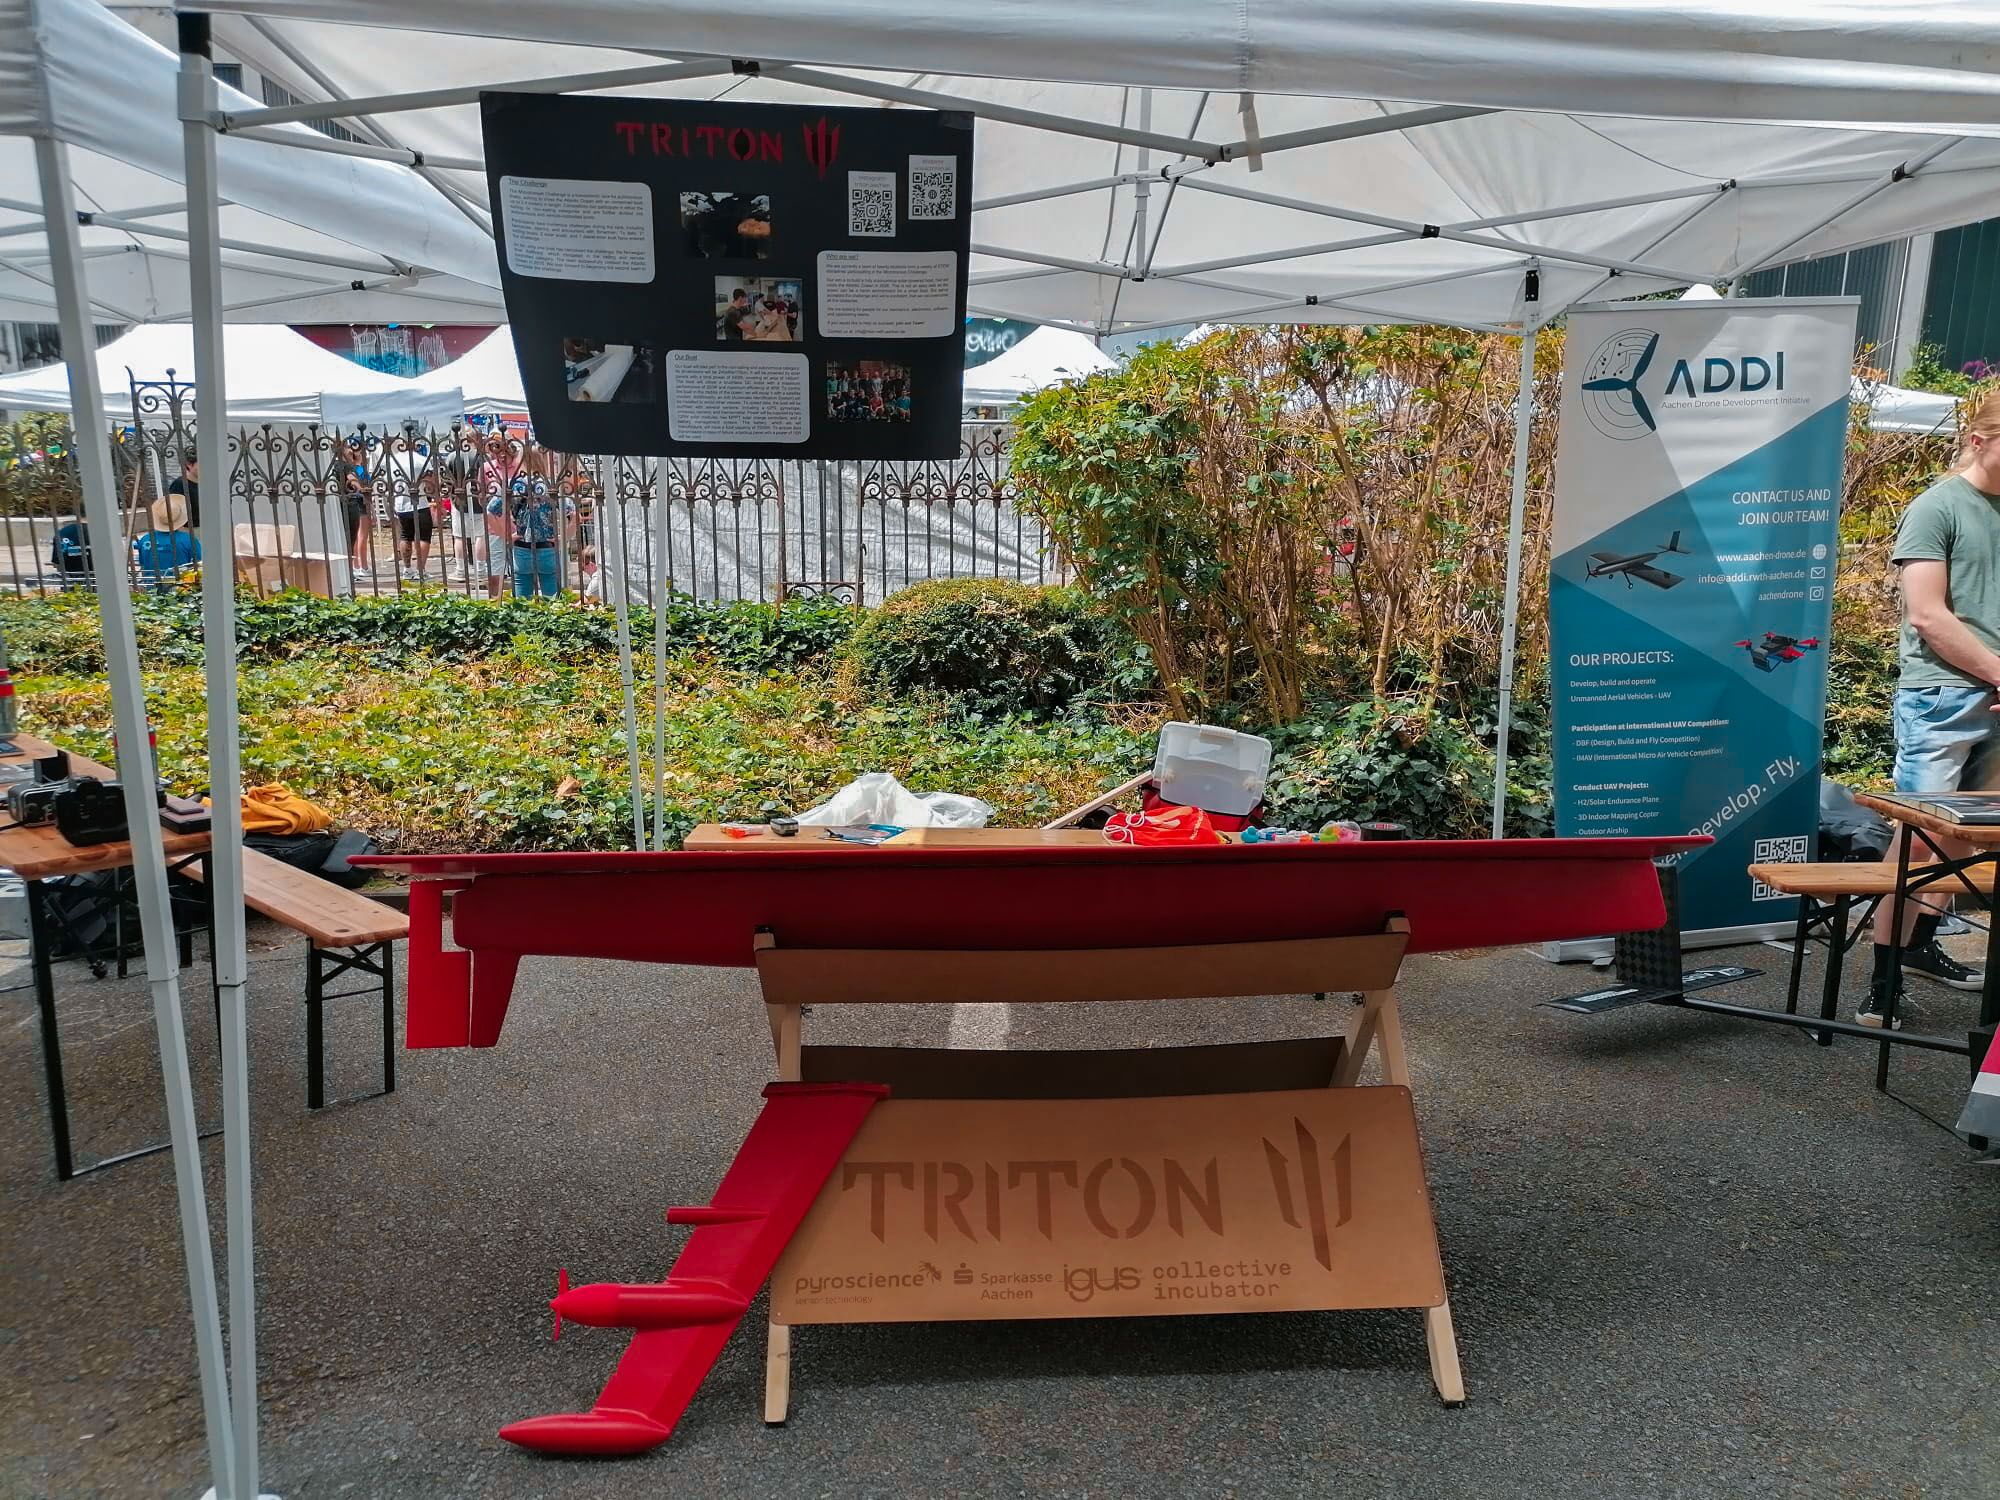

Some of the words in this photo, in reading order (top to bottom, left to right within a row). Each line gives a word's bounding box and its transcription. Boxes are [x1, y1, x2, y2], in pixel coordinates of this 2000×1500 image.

[615, 121, 784, 164] TRITON
[1664, 351, 1784, 398] ADDI
[1661, 401, 1693, 409] Aachen
[1695, 399, 1721, 408] Drone
[1722, 397, 1778, 407] Development
[1780, 396, 1811, 404] Initiative
[1732, 489, 1789, 505] CONTACT
[1791, 489, 1805, 502] US
[1806, 488, 1831, 501] AND
[1738, 512, 1769, 525] JOIN
[1772, 510, 1794, 524] OUR
[1795, 509, 1829, 522] TEAM!
[1716, 549, 1807, 562] www.aachen-drone.de
[1698, 569, 1805, 584] info@addi.rwth-aachen.de
[1758, 589, 1804, 601] aachendrone
[1570, 653, 1600, 667] OUR
[1603, 651, 1674, 665] PROJECTS:
[1570, 679, 1599, 688] Develop,
[1600, 678, 1617, 687] build
[1618, 678, 1631, 686] and
[1632, 677, 1656, 686] operate
[1570, 694, 1607, 702] Unmanned
[1627, 692, 1653, 700] Vehicles
[1571, 723, 1617, 732] Participation
[1672, 720, 1686, 728] UAV
[1576, 739, 1590, 747] DBF
[1590, 738, 1617, 747] (Design,
[1617, 737, 1635, 745] Build
[1635, 736, 1648, 744] and
[1649, 736, 1659, 745] Fly
[1659, 735, 1700, 744] Competition)
[1594, 752, 1638, 761] (International
[1638, 751, 1656, 759] Micro
[1667, 749, 1688, 758] Vehicle
[1573, 783, 1602, 791] Conduct
[1603, 782, 1617, 790] UAV
[1618, 781, 1649, 791] Projects:
[1577, 797, 1606, 806] H2/Solar
[1607, 796, 1641, 805] Endurance
[1642, 795, 1659, 804] Plane
[1688, 782, 1767, 837] Develop.
[1765, 755, 1801, 785] Fly.
[1578, 813, 1586, 821] 3D
[1587, 812, 1609, 820] Indoor
[1610, 811, 1638, 821] Mapping
[1639, 810, 1659, 819] Copter
[1578, 827, 1605, 835] Outdoor
[1606, 826, 1628, 835] Airship
[843, 1156, 1223, 1243] TRITON
[1152, 1259, 1292, 1280] collective
[795, 1272, 924, 1294] pyroscience
[980, 1273, 1053, 1285] Sparkasse
[1063, 1263, 1141, 1303] igus
[980, 1288, 1033, 1301] Aachen
[1154, 1282, 1280, 1300] incubator
